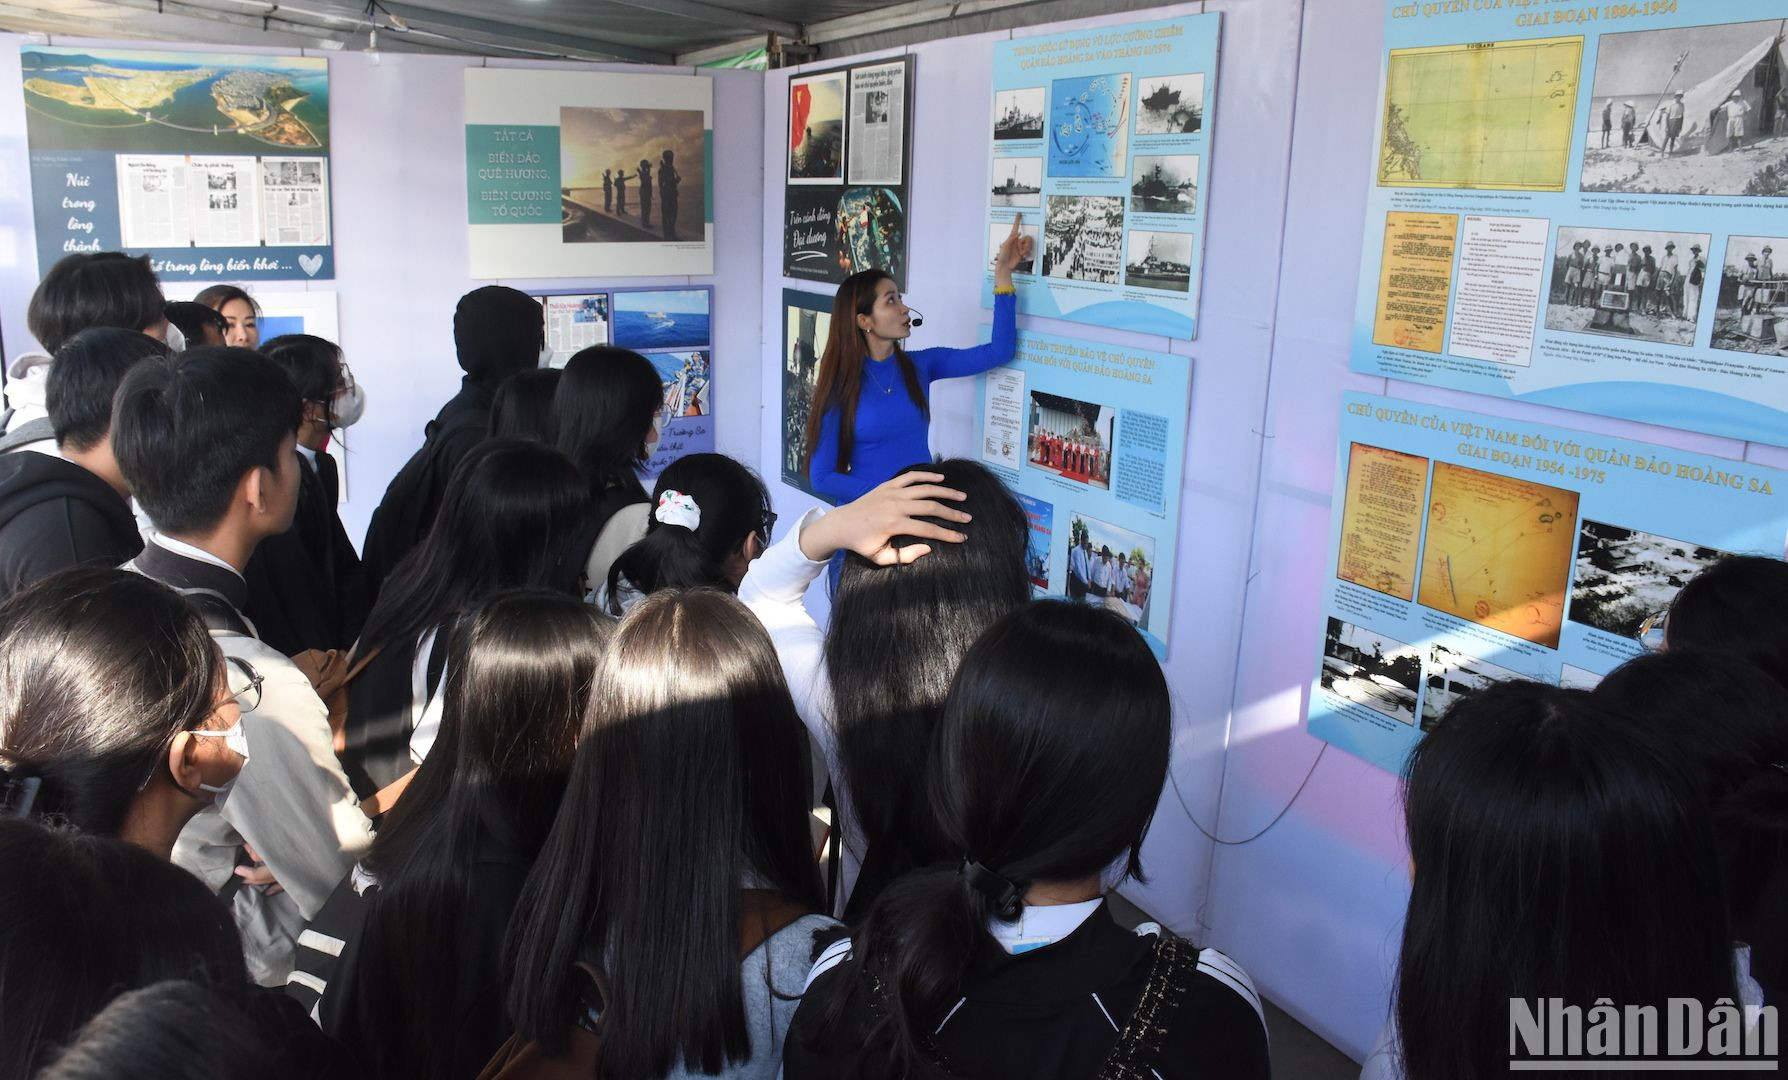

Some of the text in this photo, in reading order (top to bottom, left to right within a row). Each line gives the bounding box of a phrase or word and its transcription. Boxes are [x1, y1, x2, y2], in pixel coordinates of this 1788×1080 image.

[1515, 11, 1550, 27] GIAI
[1603, 1, 1678, 19] 1884-1954
[494, 128, 534, 141] TẤT CẢ
[488, 151, 541, 164] BIỂN ĐẢO
[66, 172, 91, 187] Núi
[478, 168, 551, 181] QUÊ HƯƠNG,
[481, 189, 552, 201] BIÊN CƯƠNG
[62, 196, 96, 213] trong
[491, 203, 543, 218] TỔ QUỐC
[790, 206, 831, 226] Trên cánh đồng
[67, 216, 95, 234] lòng
[63, 238, 103, 252] thành
[793, 227, 827, 250] Đại dương
[165, 257, 197, 275] trong
[199, 257, 225, 275] lòng
[226, 257, 251, 272] biển
[253, 256, 279, 271] khơi
[1347, 402, 1773, 496] CHỦ QUYỀN CỦA VIỆT NAM ĐỐI VỚI QUẦN ĐẢO HOÀNG SA
[1457, 442, 1489, 461] GIAI
[1491, 450, 1532, 470] ĐOẠN
[1535, 458, 1565, 477] 1954
